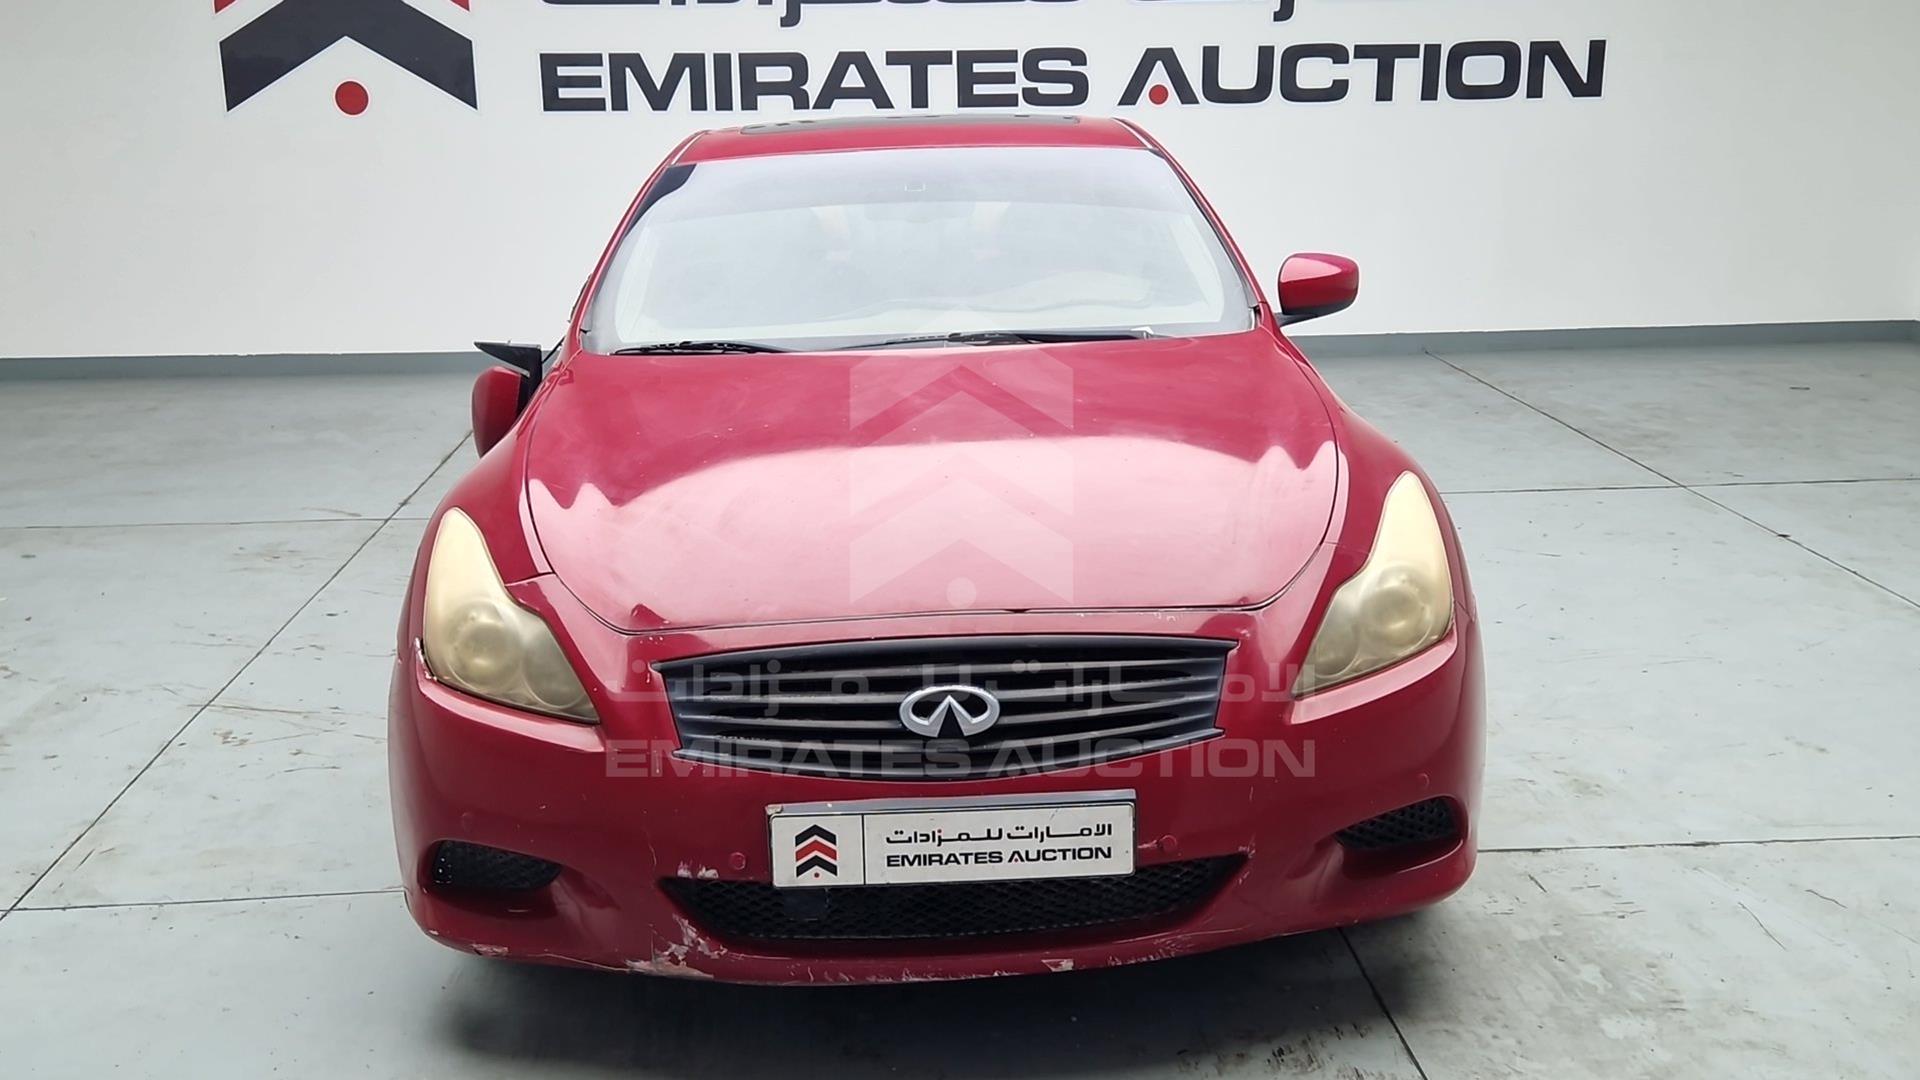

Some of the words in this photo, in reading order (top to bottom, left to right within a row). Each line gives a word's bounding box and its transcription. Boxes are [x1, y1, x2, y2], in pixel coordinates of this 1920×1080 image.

[540, 47, 1090, 112] EMIRATES
[1118, 39, 1607, 107] AUCTION
[886, 827, 1003, 848] للمزادات
[1006, 823, 1112, 844] الامارات
[886, 851, 1003, 867] EMIRATES
[1008, 846, 1112, 863] AUCTION
